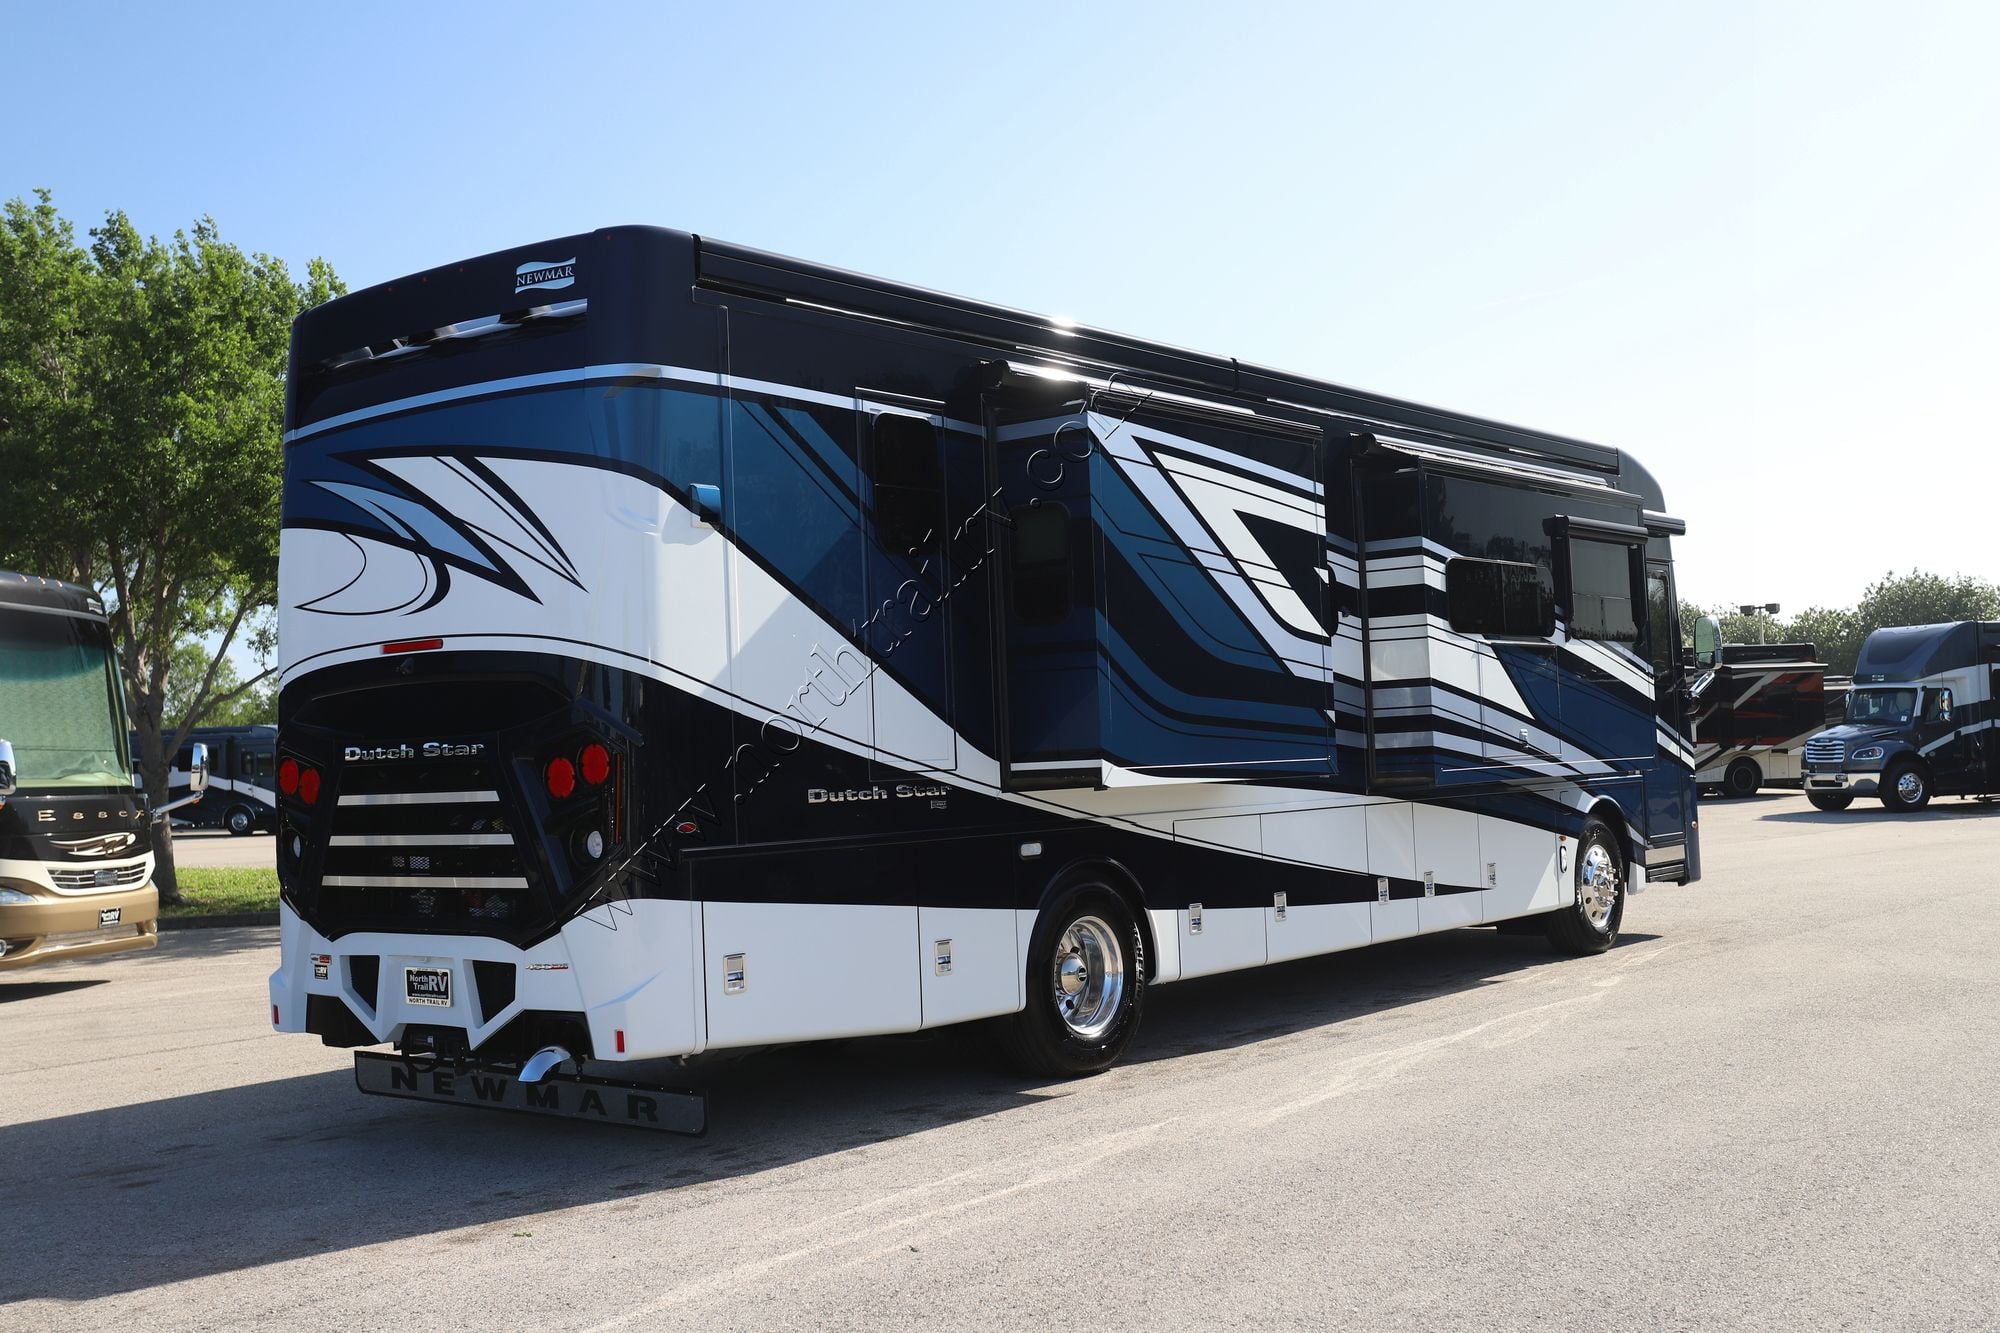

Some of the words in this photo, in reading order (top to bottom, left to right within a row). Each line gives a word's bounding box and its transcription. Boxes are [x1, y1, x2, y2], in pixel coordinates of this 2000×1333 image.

[516, 266, 575, 287] NEWMAR
[344, 743, 414, 761] Dutch
[422, 741, 485, 757] Star
[807, 785, 888, 804] Dutch
[895, 783, 952, 798] Star
[409, 974, 428, 982] North
[428, 975, 447, 991] RV
[391, 1066, 659, 1123] NEWMAR
